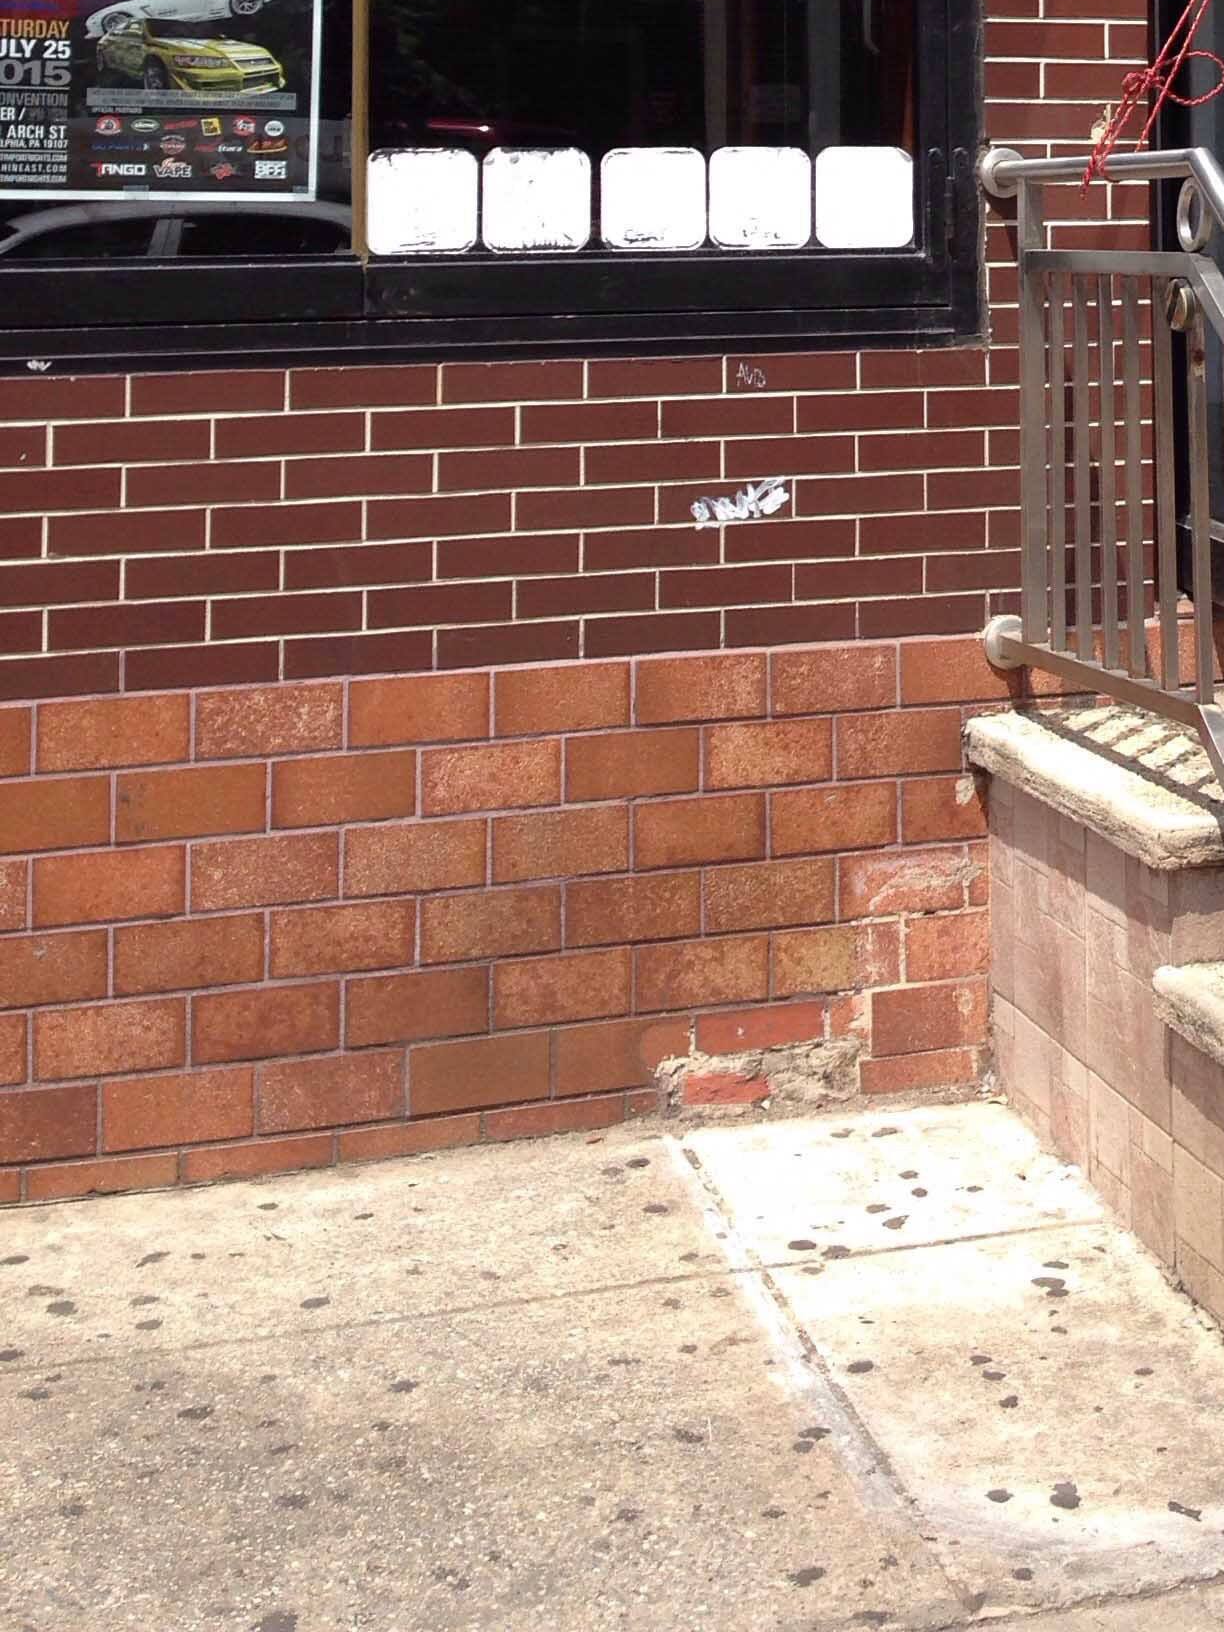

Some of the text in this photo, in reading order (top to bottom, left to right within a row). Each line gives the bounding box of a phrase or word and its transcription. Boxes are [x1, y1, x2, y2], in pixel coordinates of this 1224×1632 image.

[43, 40, 71, 58] 25
[7, 124, 67, 139] ARCH ST
[29, 139, 41, 148] PA
[43, 139, 69, 148] 19107
